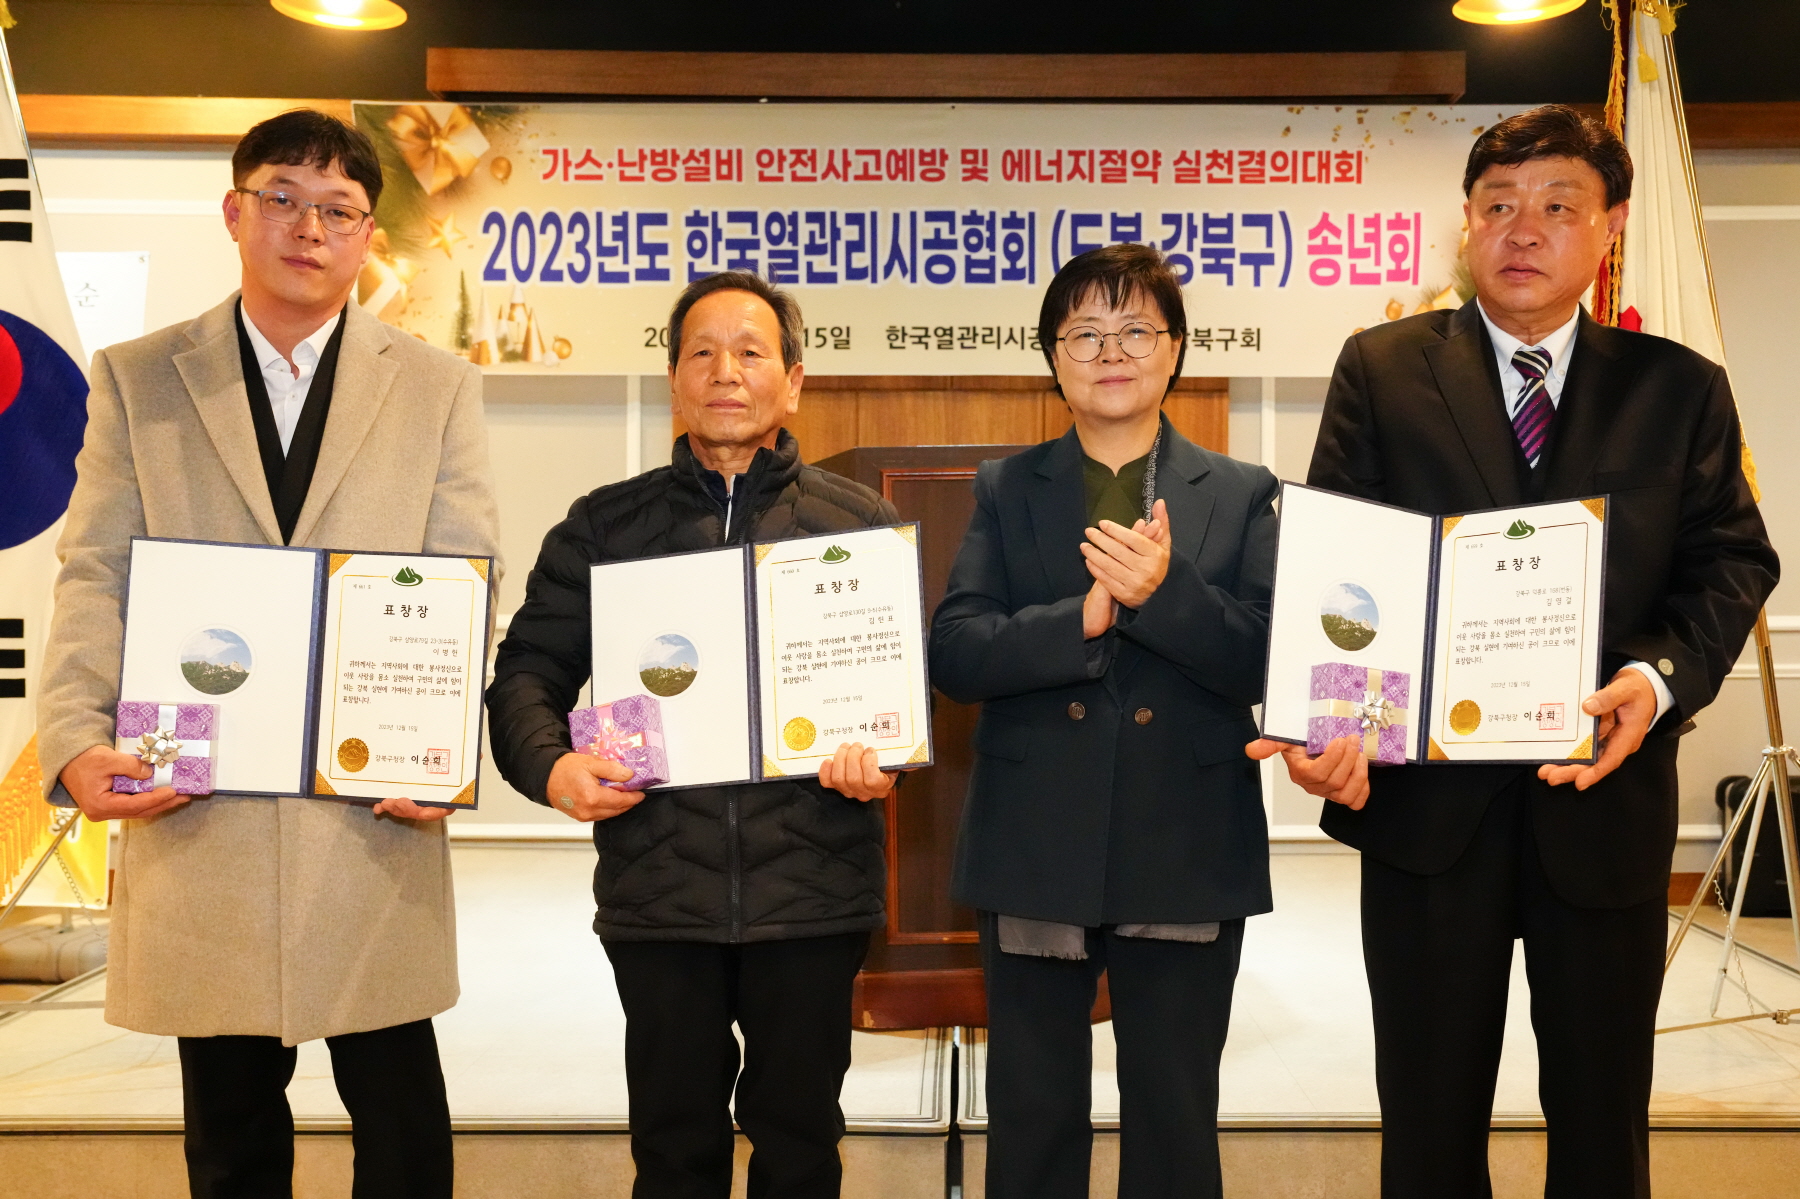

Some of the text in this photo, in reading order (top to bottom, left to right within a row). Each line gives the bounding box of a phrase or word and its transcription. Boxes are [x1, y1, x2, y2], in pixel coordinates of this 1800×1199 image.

[541, 147, 1364, 185] 가스·난방설비 안전사고예방 및 에너지절약 실천결의대회
[482, 210, 671, 284] 2023년도
[684, 208, 1036, 285] 한국열관리시공협회
[1307, 211, 1422, 286] 송년회
[885, 326, 1042, 351] 한국열관리시공
[1185, 327, 1261, 351] 북구회
[1488, 714, 1518, 722] 강북구청장
[823, 726, 854, 736] 강북구청장
[376, 754, 405, 763] 강북구청장
